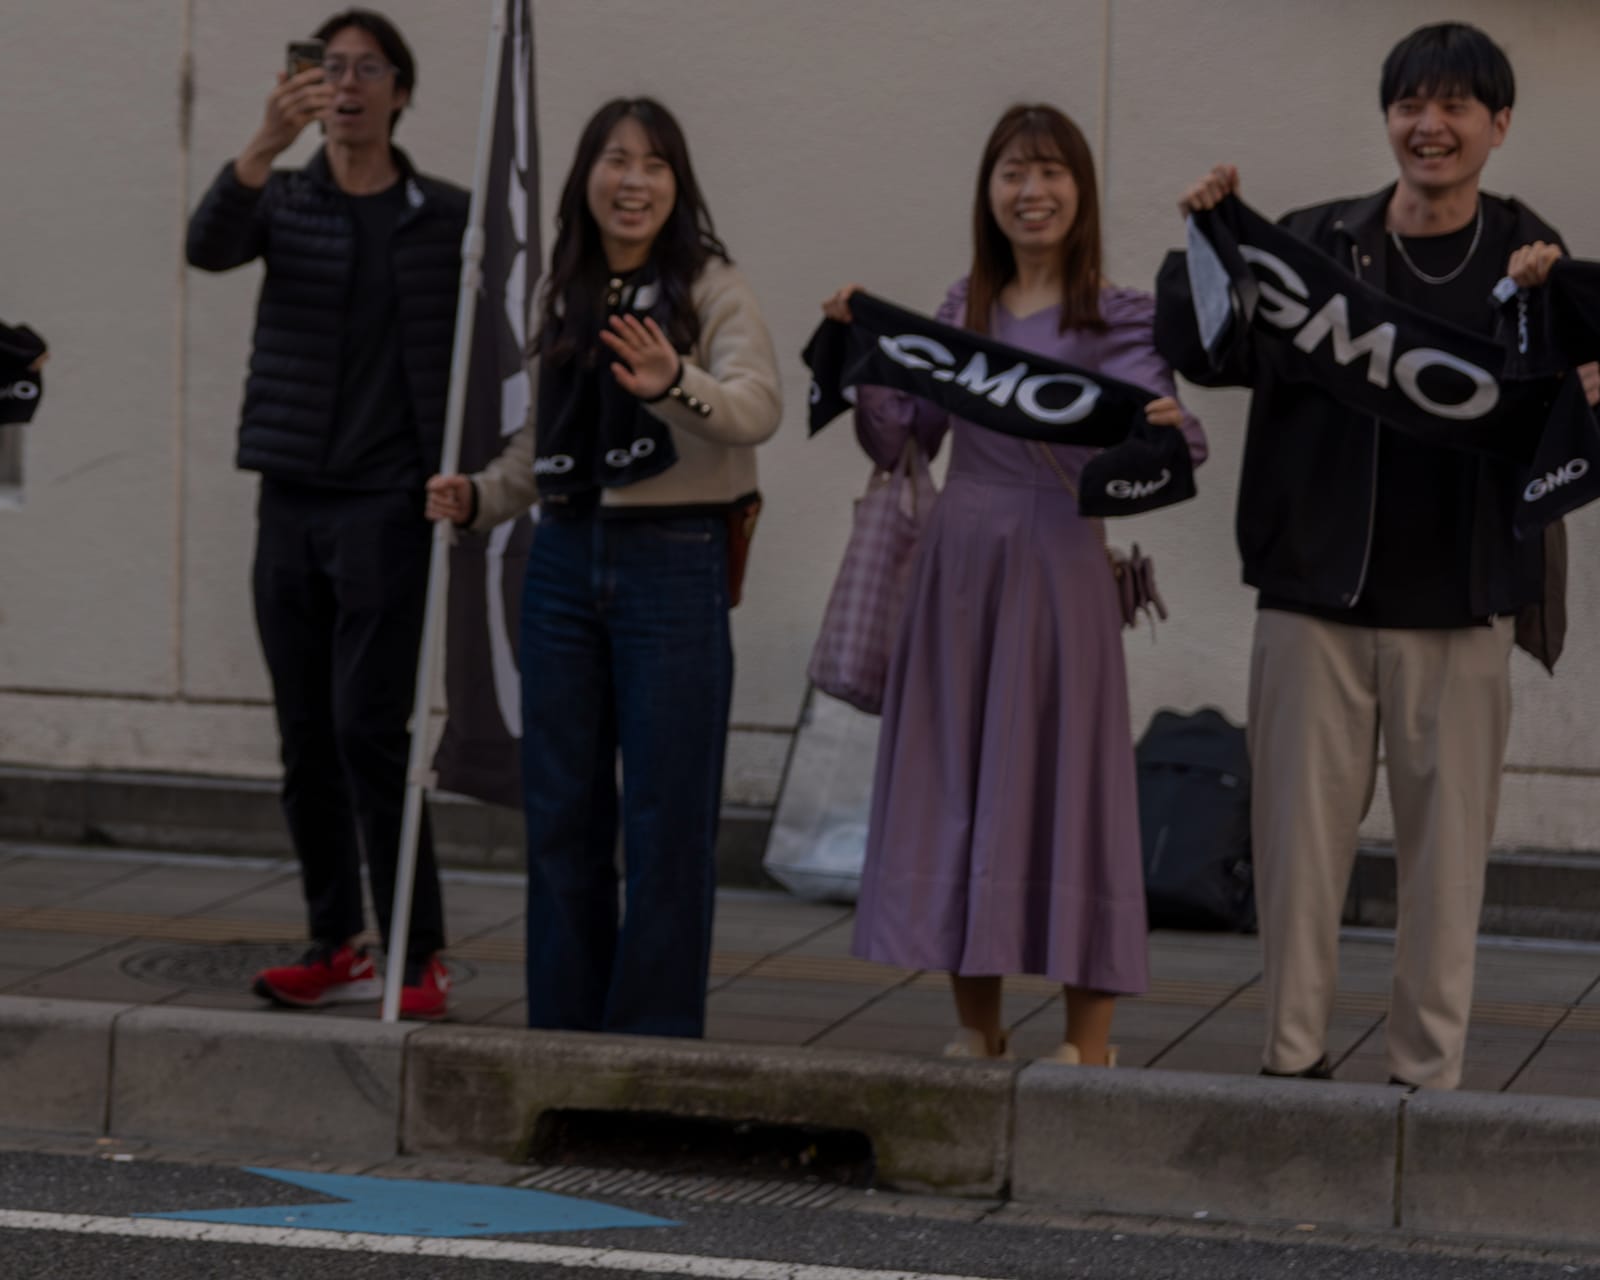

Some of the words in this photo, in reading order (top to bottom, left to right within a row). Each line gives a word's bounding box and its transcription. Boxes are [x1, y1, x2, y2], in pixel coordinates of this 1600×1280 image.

[1238, 244, 1500, 420] GMO
[878, 333, 1104, 425] GMO
[1522, 457, 1590, 502] GMO
